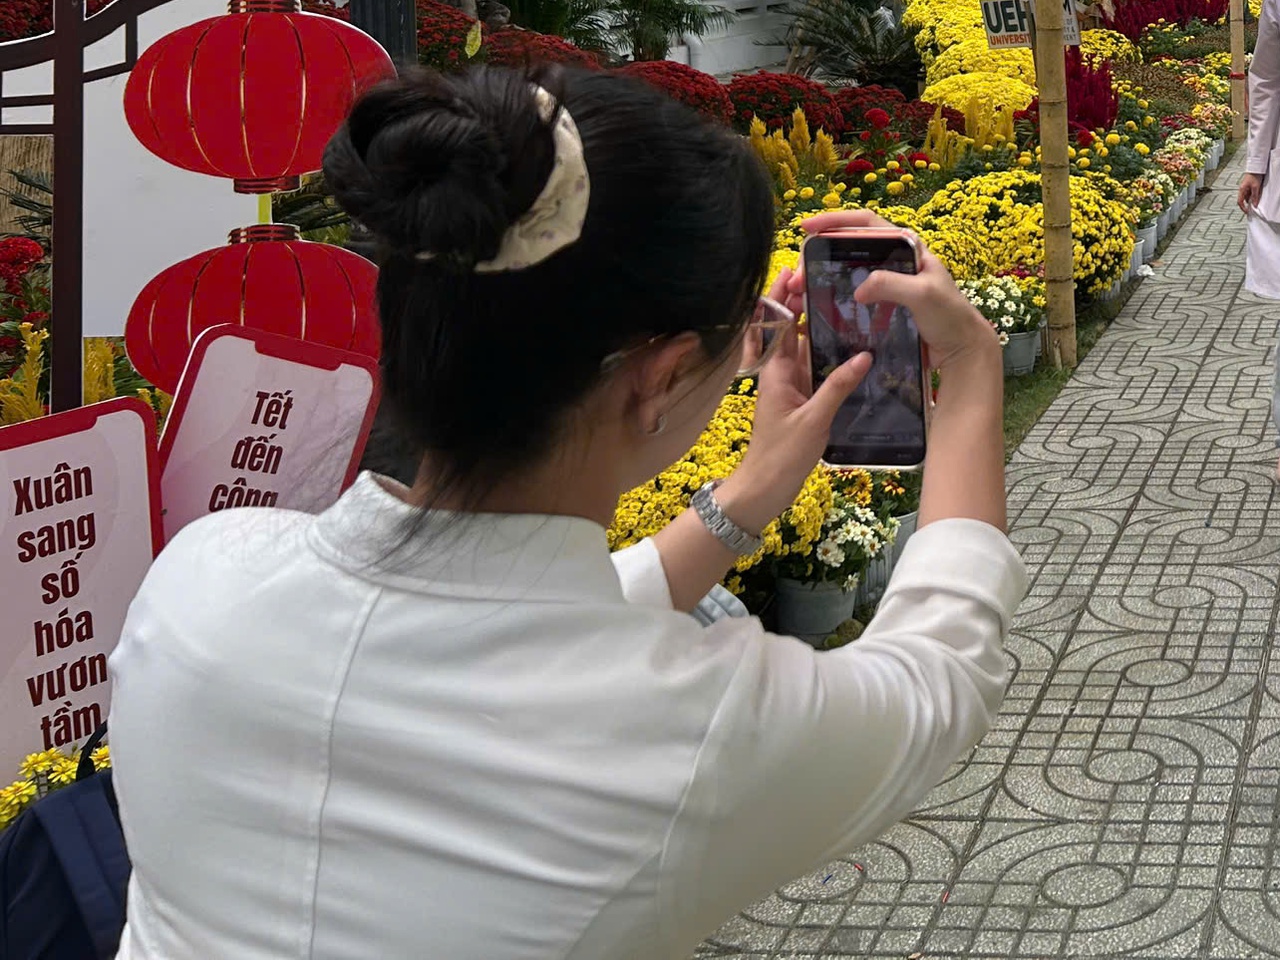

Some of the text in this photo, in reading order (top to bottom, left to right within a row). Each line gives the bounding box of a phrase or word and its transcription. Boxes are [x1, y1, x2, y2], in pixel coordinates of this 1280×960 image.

[983, 0, 1036, 34] UEH
[990, 33, 1032, 46] UNIVERSIT
[251, 389, 293, 430] Tết
[231, 433, 284, 475] đến
[13, 461, 94, 517] Xuân
[17, 512, 97, 564] sang
[40, 551, 84, 605] số
[33, 607, 95, 657] hóa
[26, 651, 108, 708] vươn
[40, 700, 101, 752] tầm
